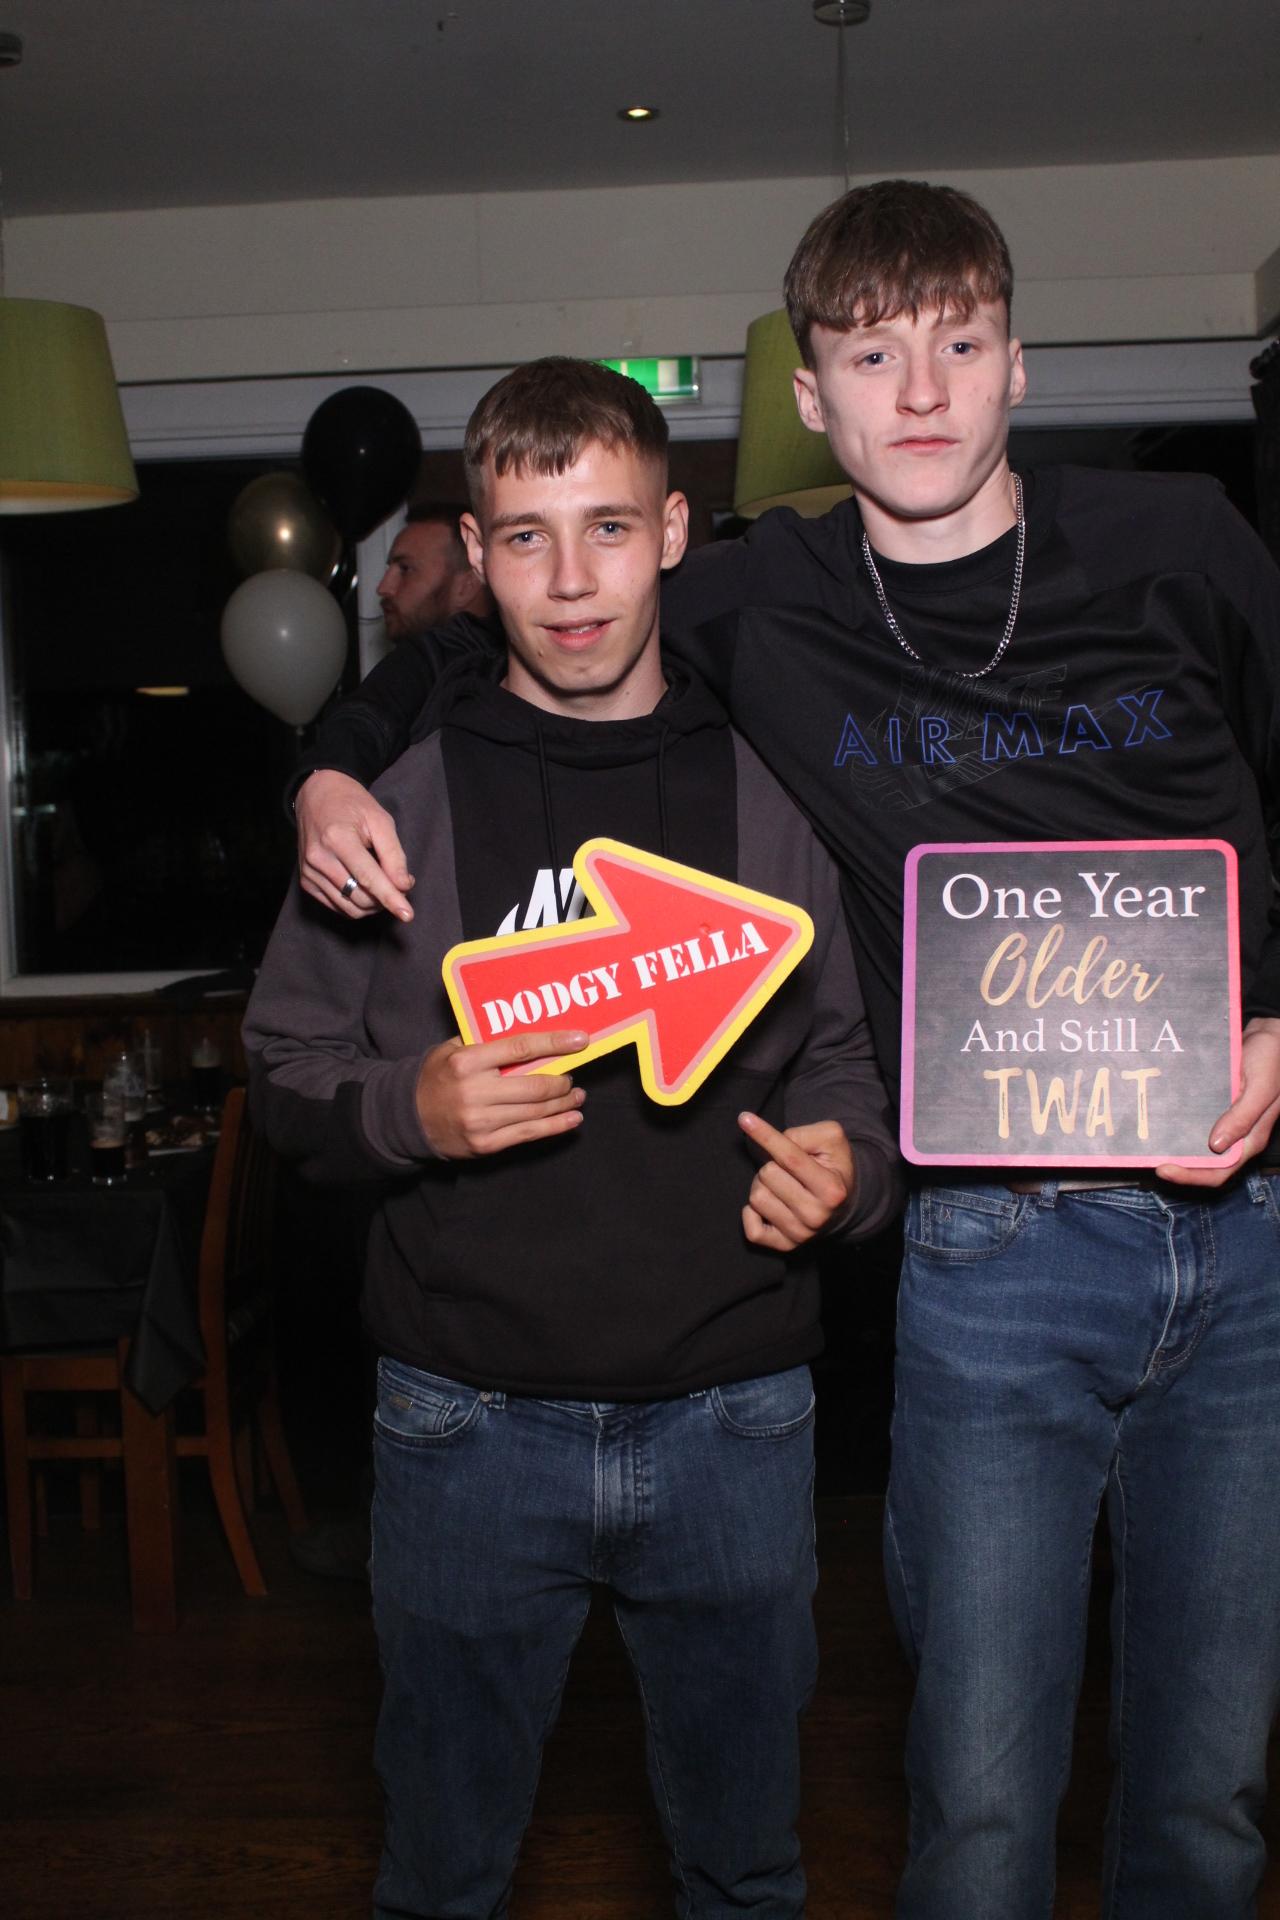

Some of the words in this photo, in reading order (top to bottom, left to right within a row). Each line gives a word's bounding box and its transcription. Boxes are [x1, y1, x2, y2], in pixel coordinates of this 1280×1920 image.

[942, 873, 1062, 920] One
[1078, 872, 1206, 918] Year
[481, 963, 622, 1035] DODGY
[631, 922, 769, 989] FELLA
[979, 923, 1165, 1009] Older
[960, 1019, 1045, 1052] And
[1059, 1018, 1137, 1052] Still
[1150, 1020, 1184, 1052] A
[983, 1067, 1162, 1140] TWAT
